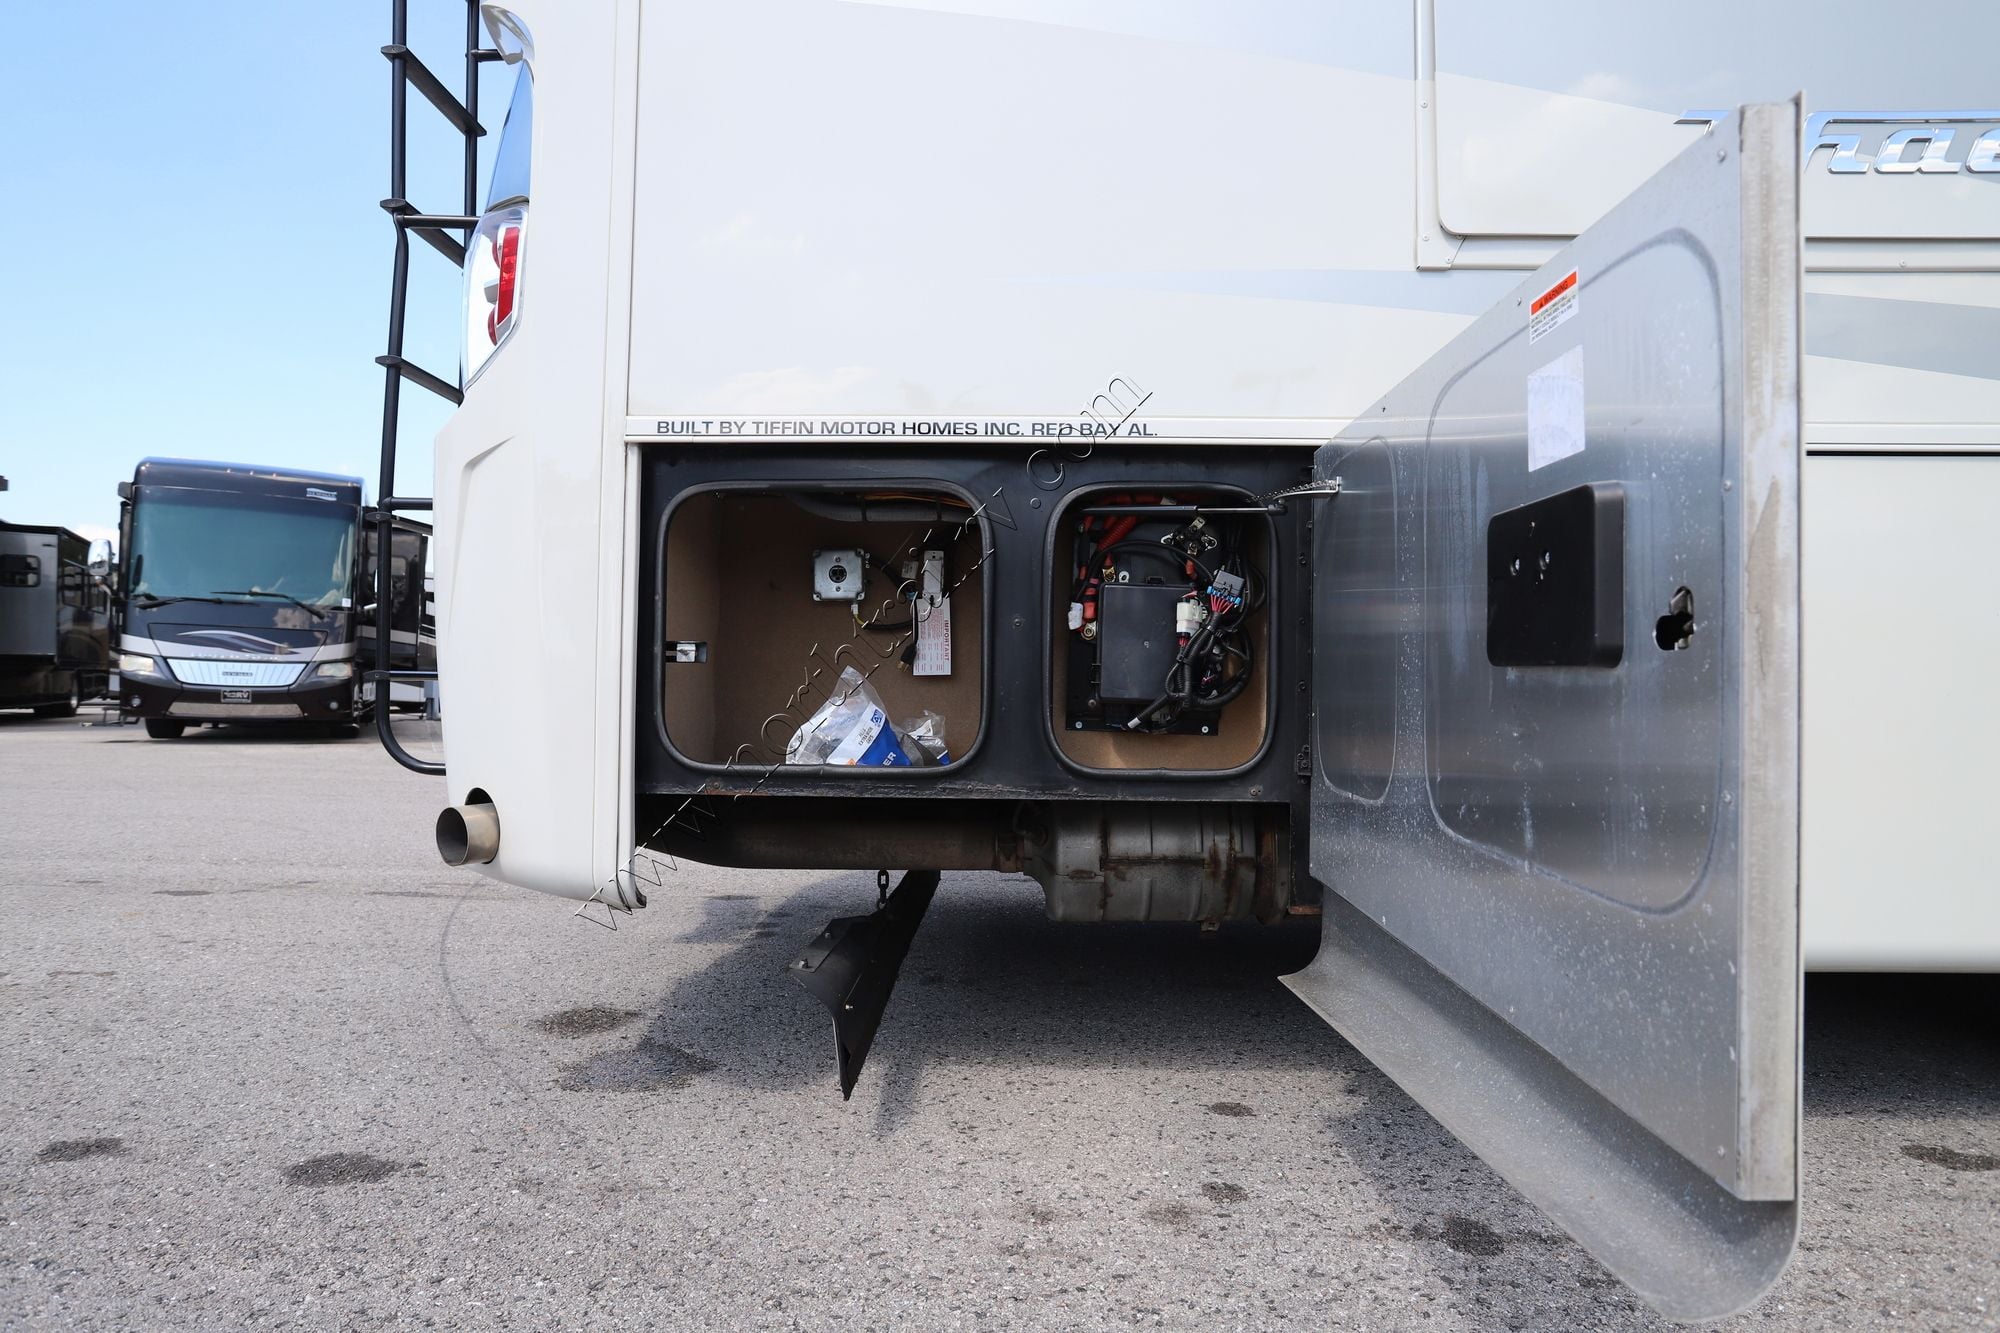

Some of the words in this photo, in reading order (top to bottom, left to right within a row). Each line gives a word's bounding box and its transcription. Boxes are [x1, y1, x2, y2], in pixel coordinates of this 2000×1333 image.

[657, 421, 714, 434] BUILT
[719, 421, 747, 434] BY
[751, 421, 814, 435] TIFFIN
[821, 421, 896, 435] MOTOR
[902, 422, 978, 435] HOMES
[985, 422, 1025, 436] INC.
[1032, 422, 1073, 436] RED
[1080, 422, 1122, 436] BAY
[1127, 422, 1159, 436] AL.
